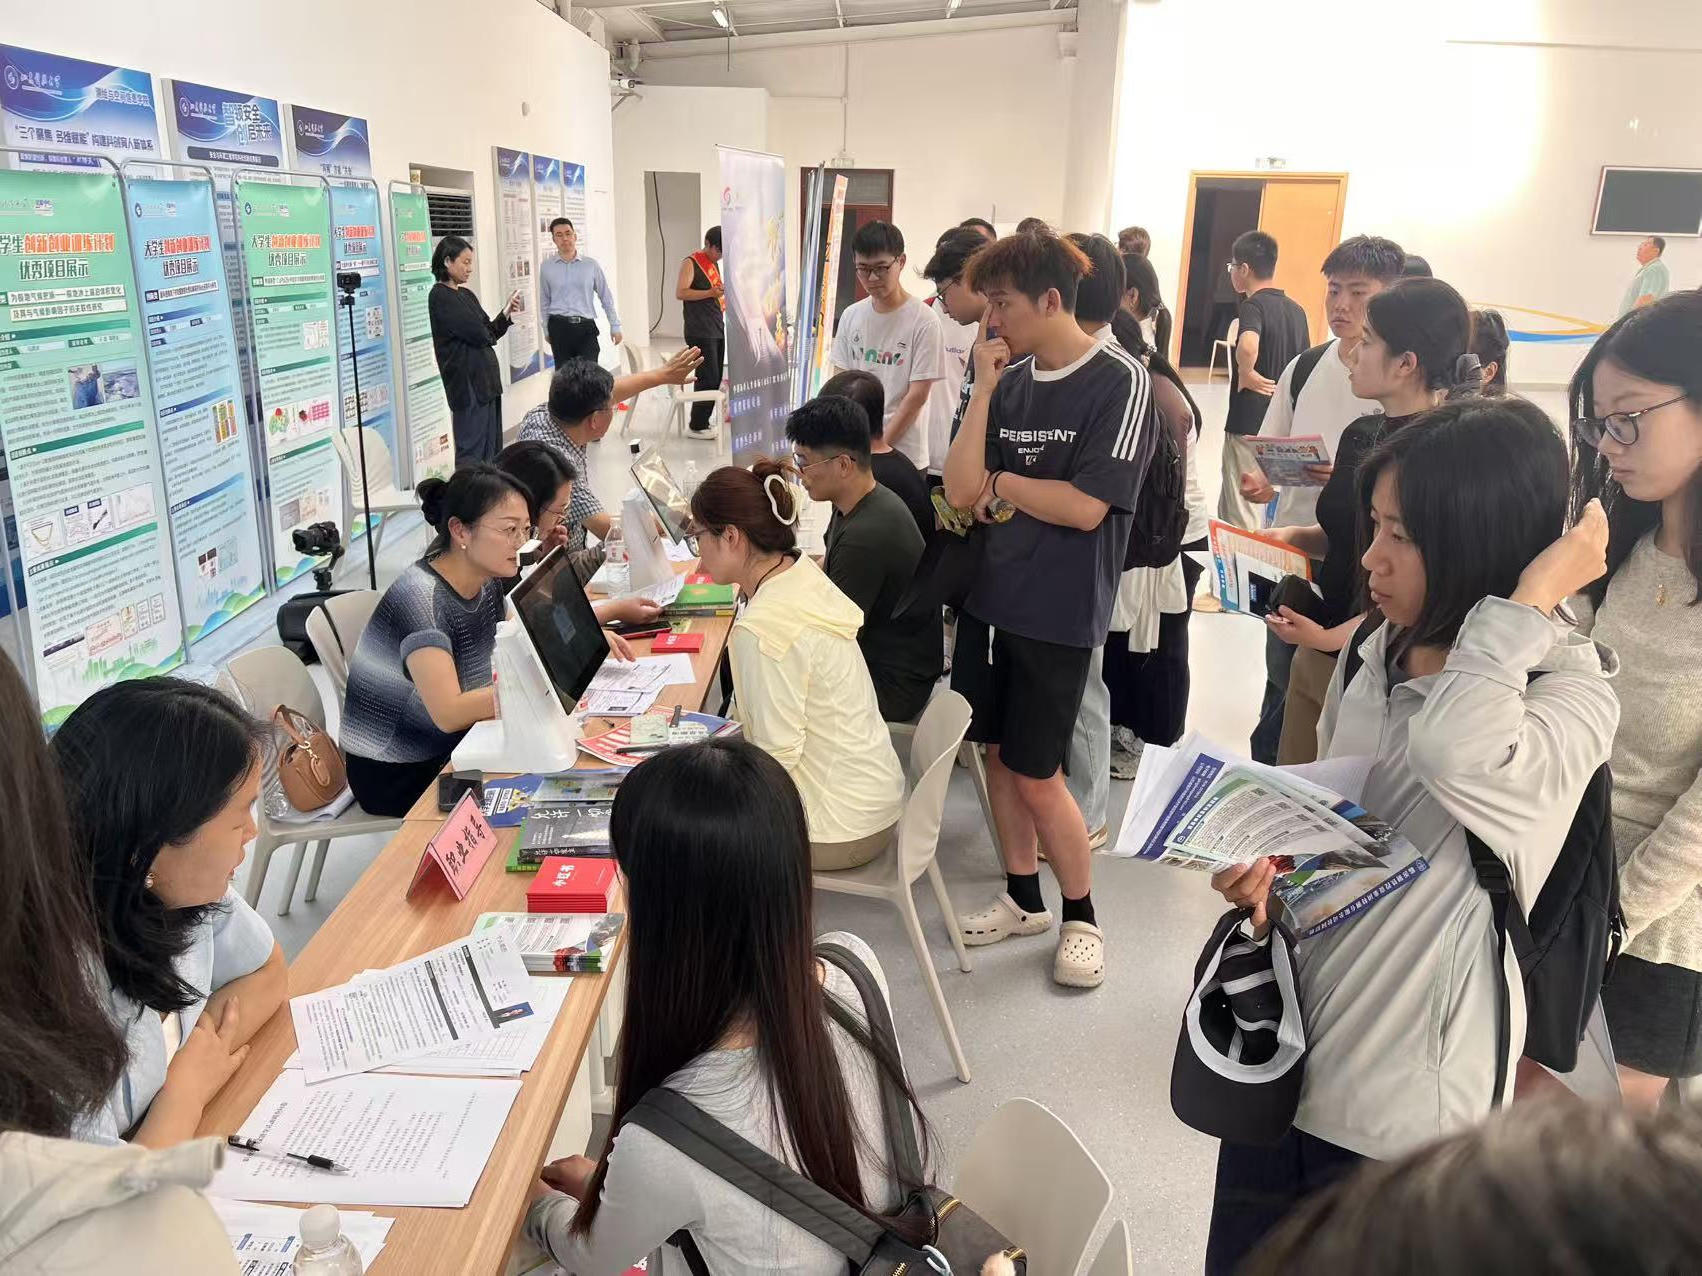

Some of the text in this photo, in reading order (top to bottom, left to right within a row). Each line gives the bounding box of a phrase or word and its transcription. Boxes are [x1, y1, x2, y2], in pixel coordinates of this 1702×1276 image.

[20, 259, 90, 280] 优秀项目展示
[445, 813, 486, 876] 职业指导
